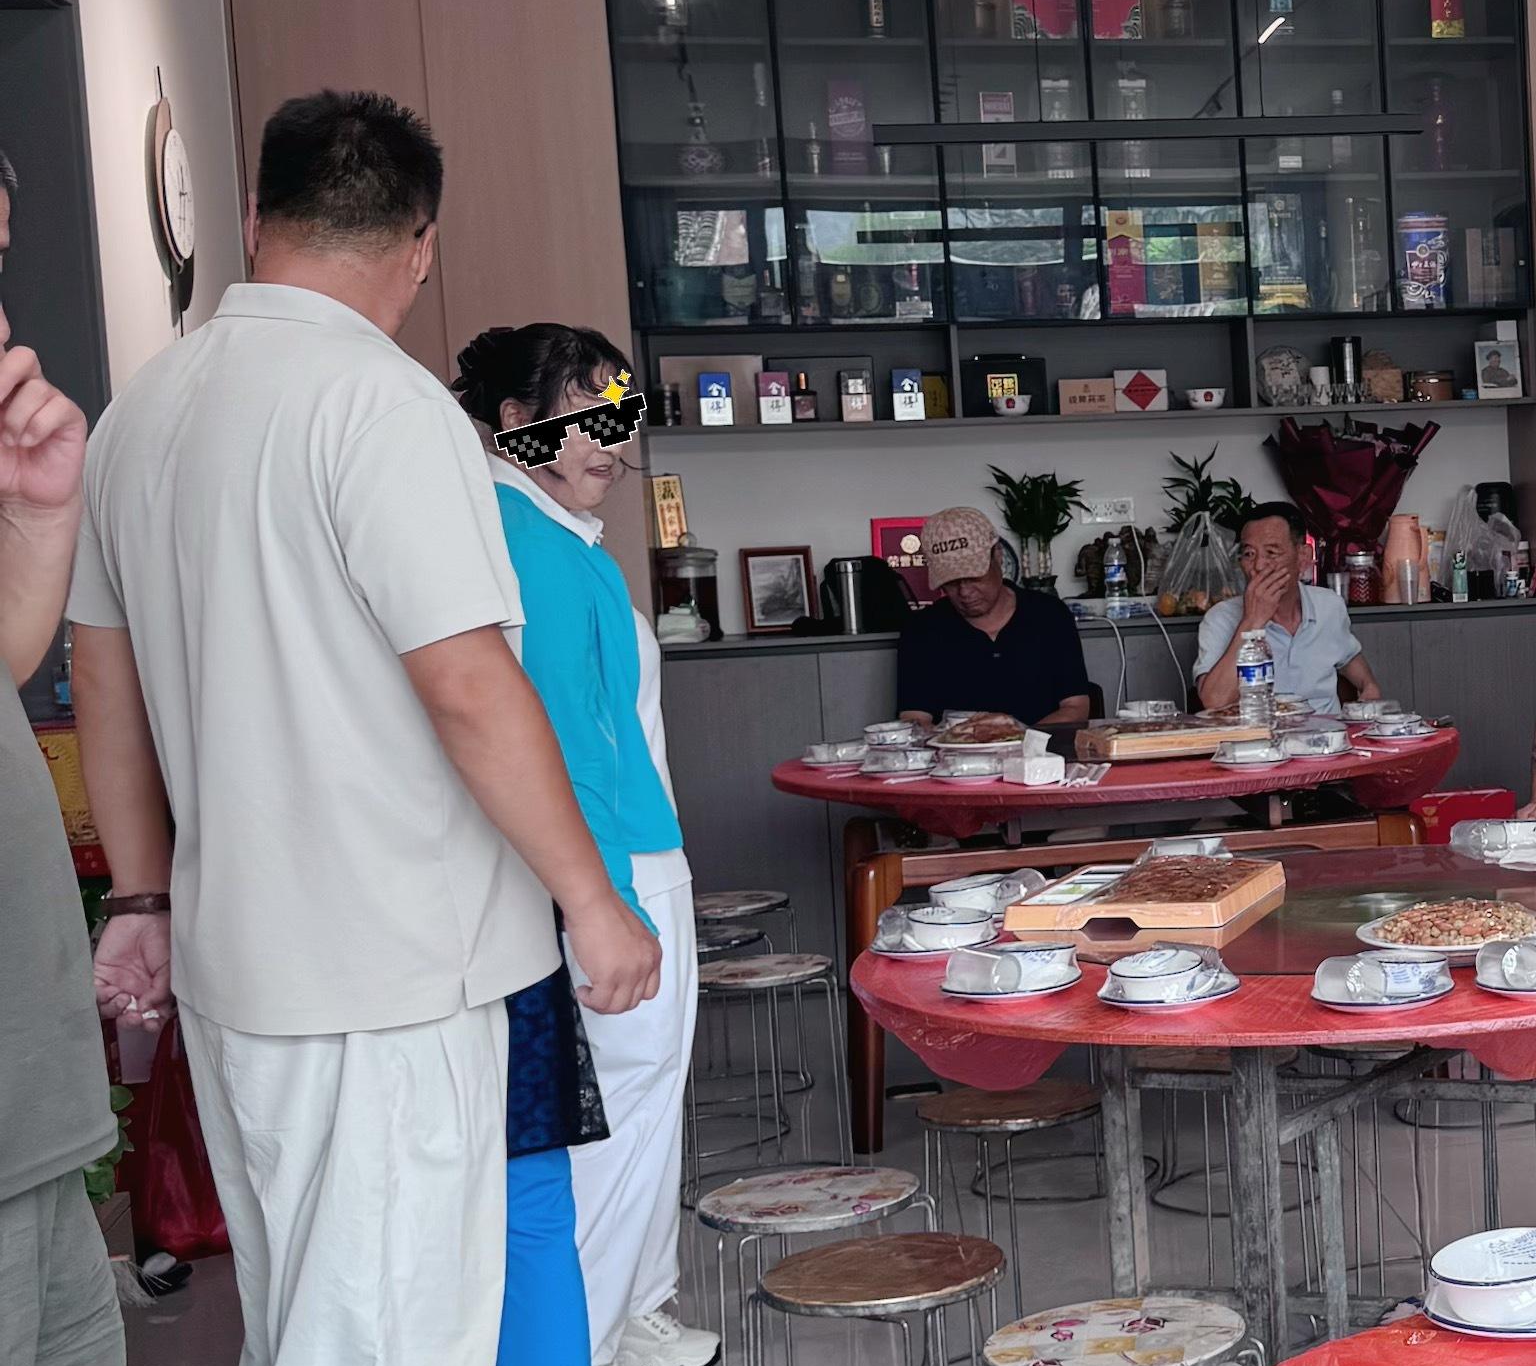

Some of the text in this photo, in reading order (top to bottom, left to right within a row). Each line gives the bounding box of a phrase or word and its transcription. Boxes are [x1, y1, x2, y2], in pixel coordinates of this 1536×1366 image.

[931, 536, 969, 555] GUZB
[887, 554, 928, 568] 荣誉证
